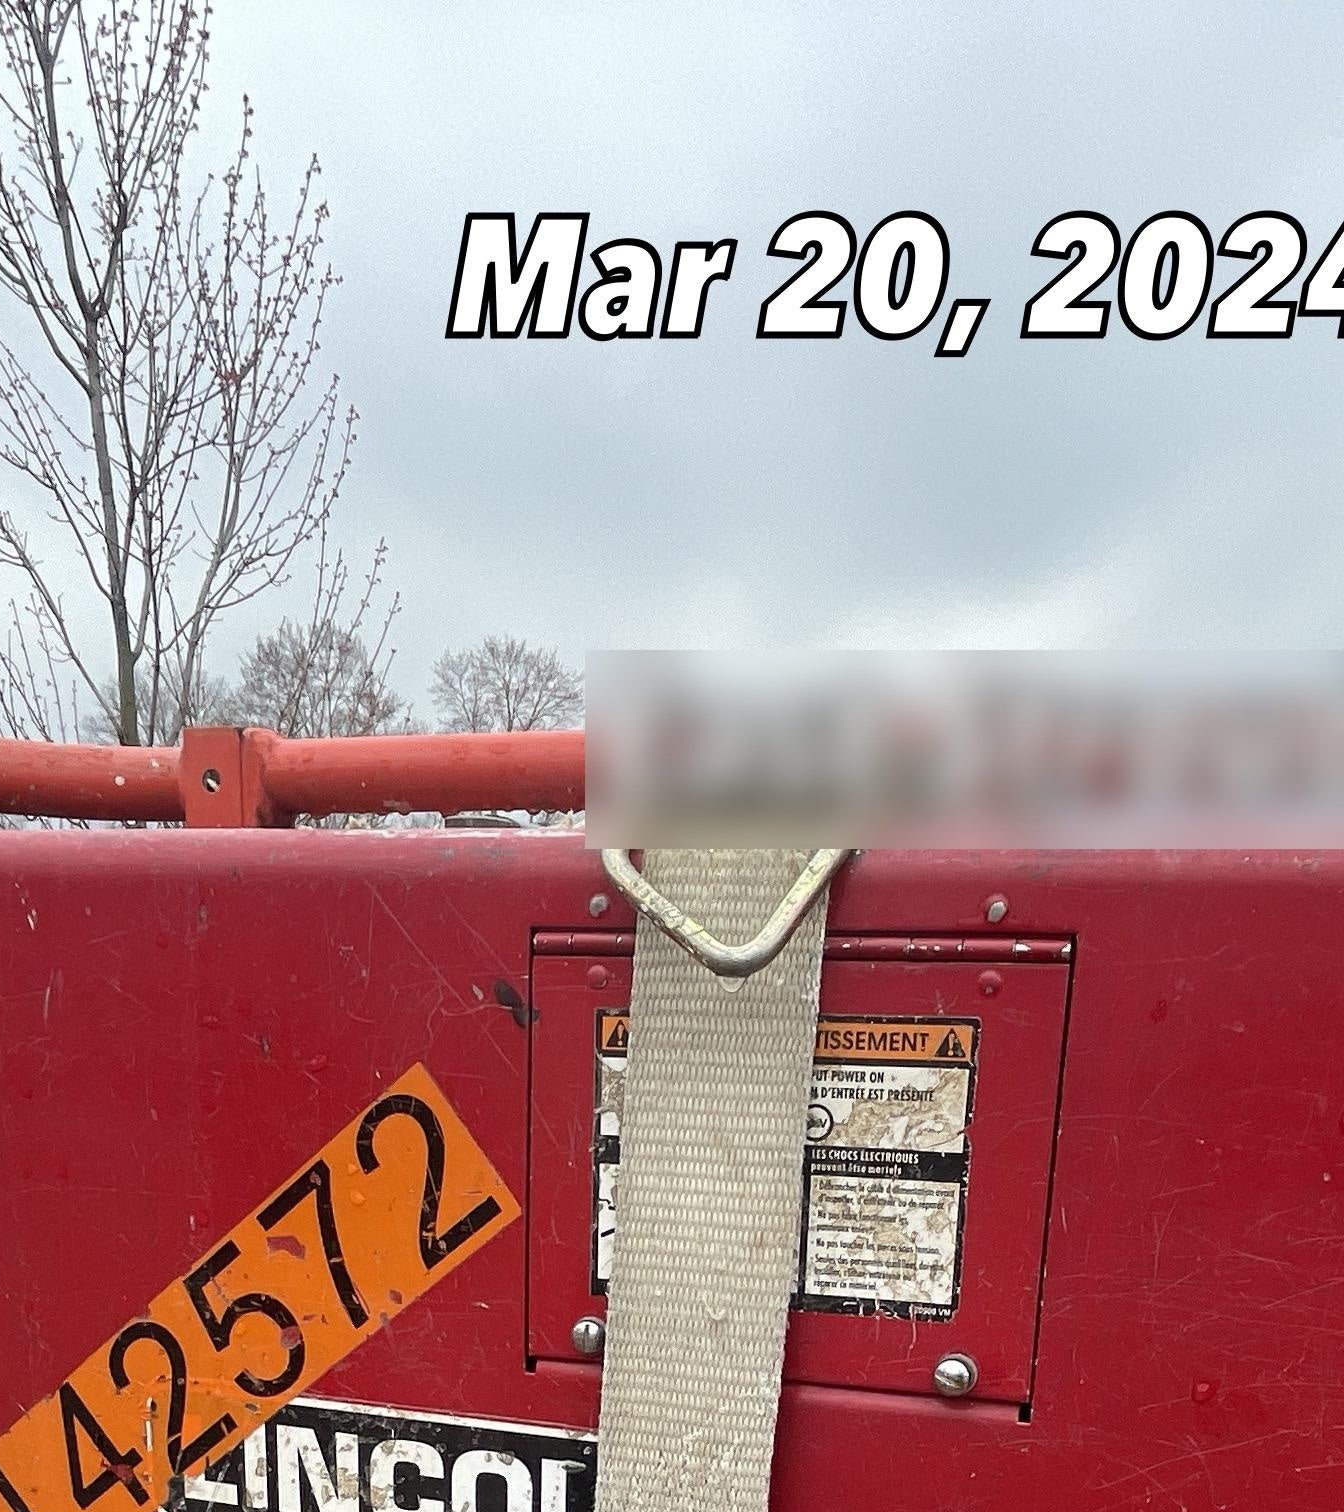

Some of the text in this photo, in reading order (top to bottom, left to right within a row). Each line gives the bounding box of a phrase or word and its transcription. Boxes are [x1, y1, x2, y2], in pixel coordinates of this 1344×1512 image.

[831, 1070, 866, 1083] POWER
[869, 1072, 885, 1083] ON
[867, 1088, 885, 1100] EST
[812, 1149, 826, 1160] LES
[828, 1150, 859, 1162] CHOCS
[811, 1163, 846, 1174] peuvent
